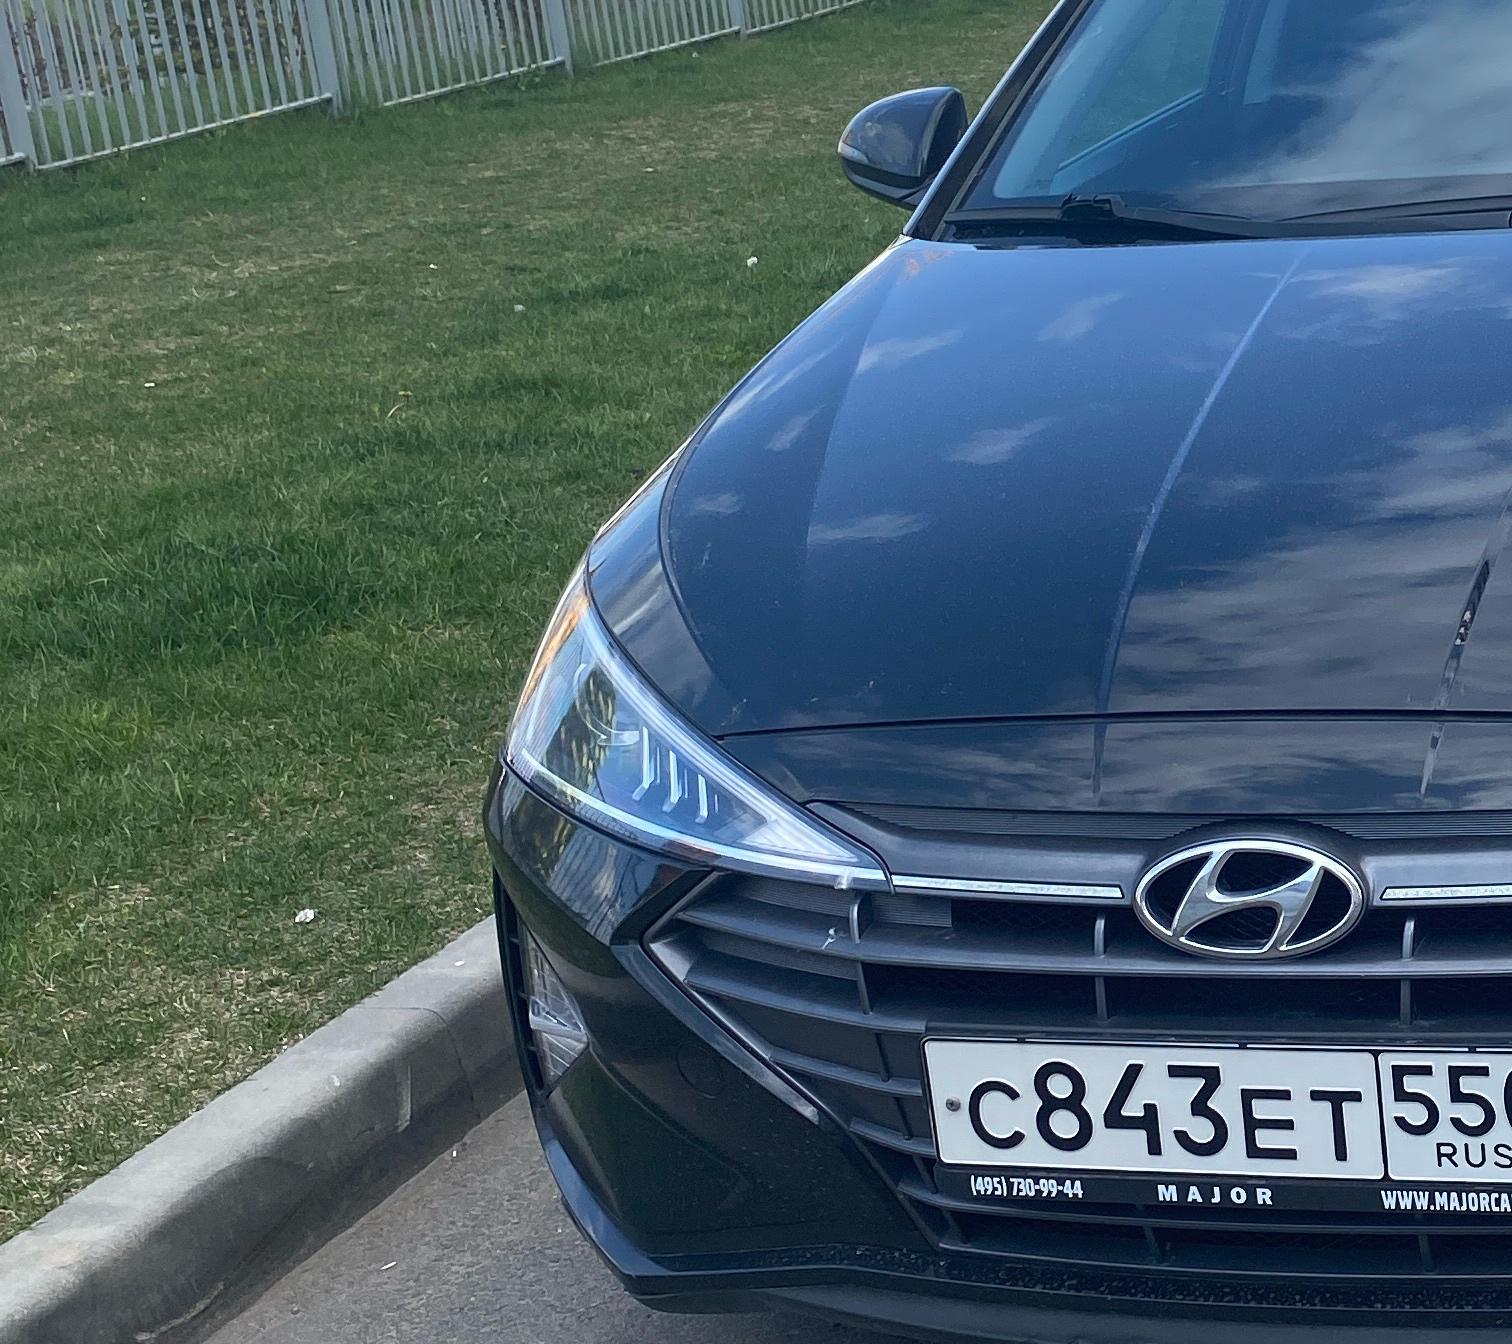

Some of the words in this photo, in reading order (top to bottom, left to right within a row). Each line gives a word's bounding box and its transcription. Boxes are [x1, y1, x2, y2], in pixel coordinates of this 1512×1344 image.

[968, 1061, 1362, 1161] С843ЕТ
[971, 1175, 1007, 1197] (495)
[1009, 1177, 1083, 1199] 730-99-44
[1158, 1184, 1273, 1205] MAJOR
